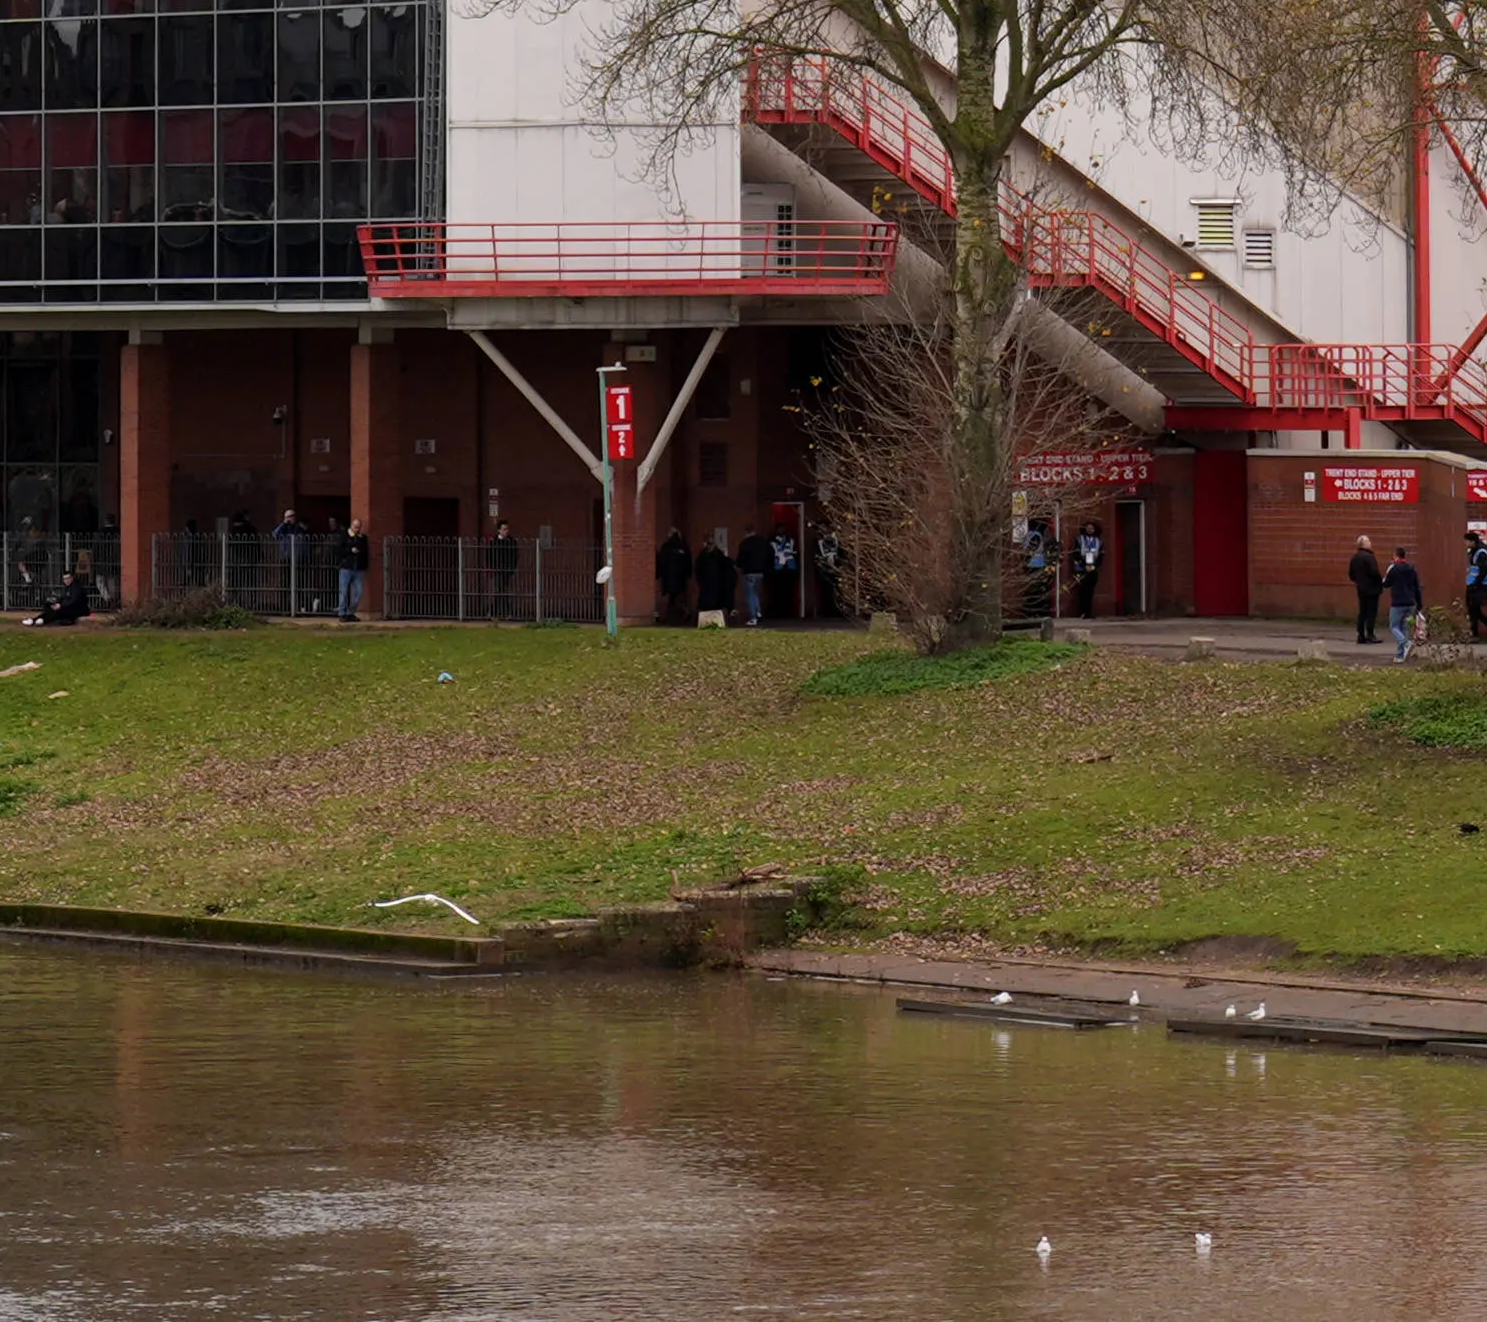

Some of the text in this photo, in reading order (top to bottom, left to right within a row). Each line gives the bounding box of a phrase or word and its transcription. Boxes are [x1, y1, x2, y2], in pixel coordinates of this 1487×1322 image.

[616, 395, 626, 419] 1
[618, 431, 625, 444] 2
[1020, 467, 1082, 482] BLOCKS
[1111, 466, 1119, 480] 2
[1123, 466, 1134, 479] &
[1139, 465, 1148, 479] 3
[1344, 479, 1375, 490] BLOCKS
[1377, 479, 1381, 489] 1
[1388, 480, 1393, 489] 2
[1394, 480, 1400, 489] &
[1401, 480, 1407, 490] 3
[1338, 492, 1361, 500] BLOCKS
[1378, 492, 1390, 500] FAR
[1391, 492, 1403, 501] END
